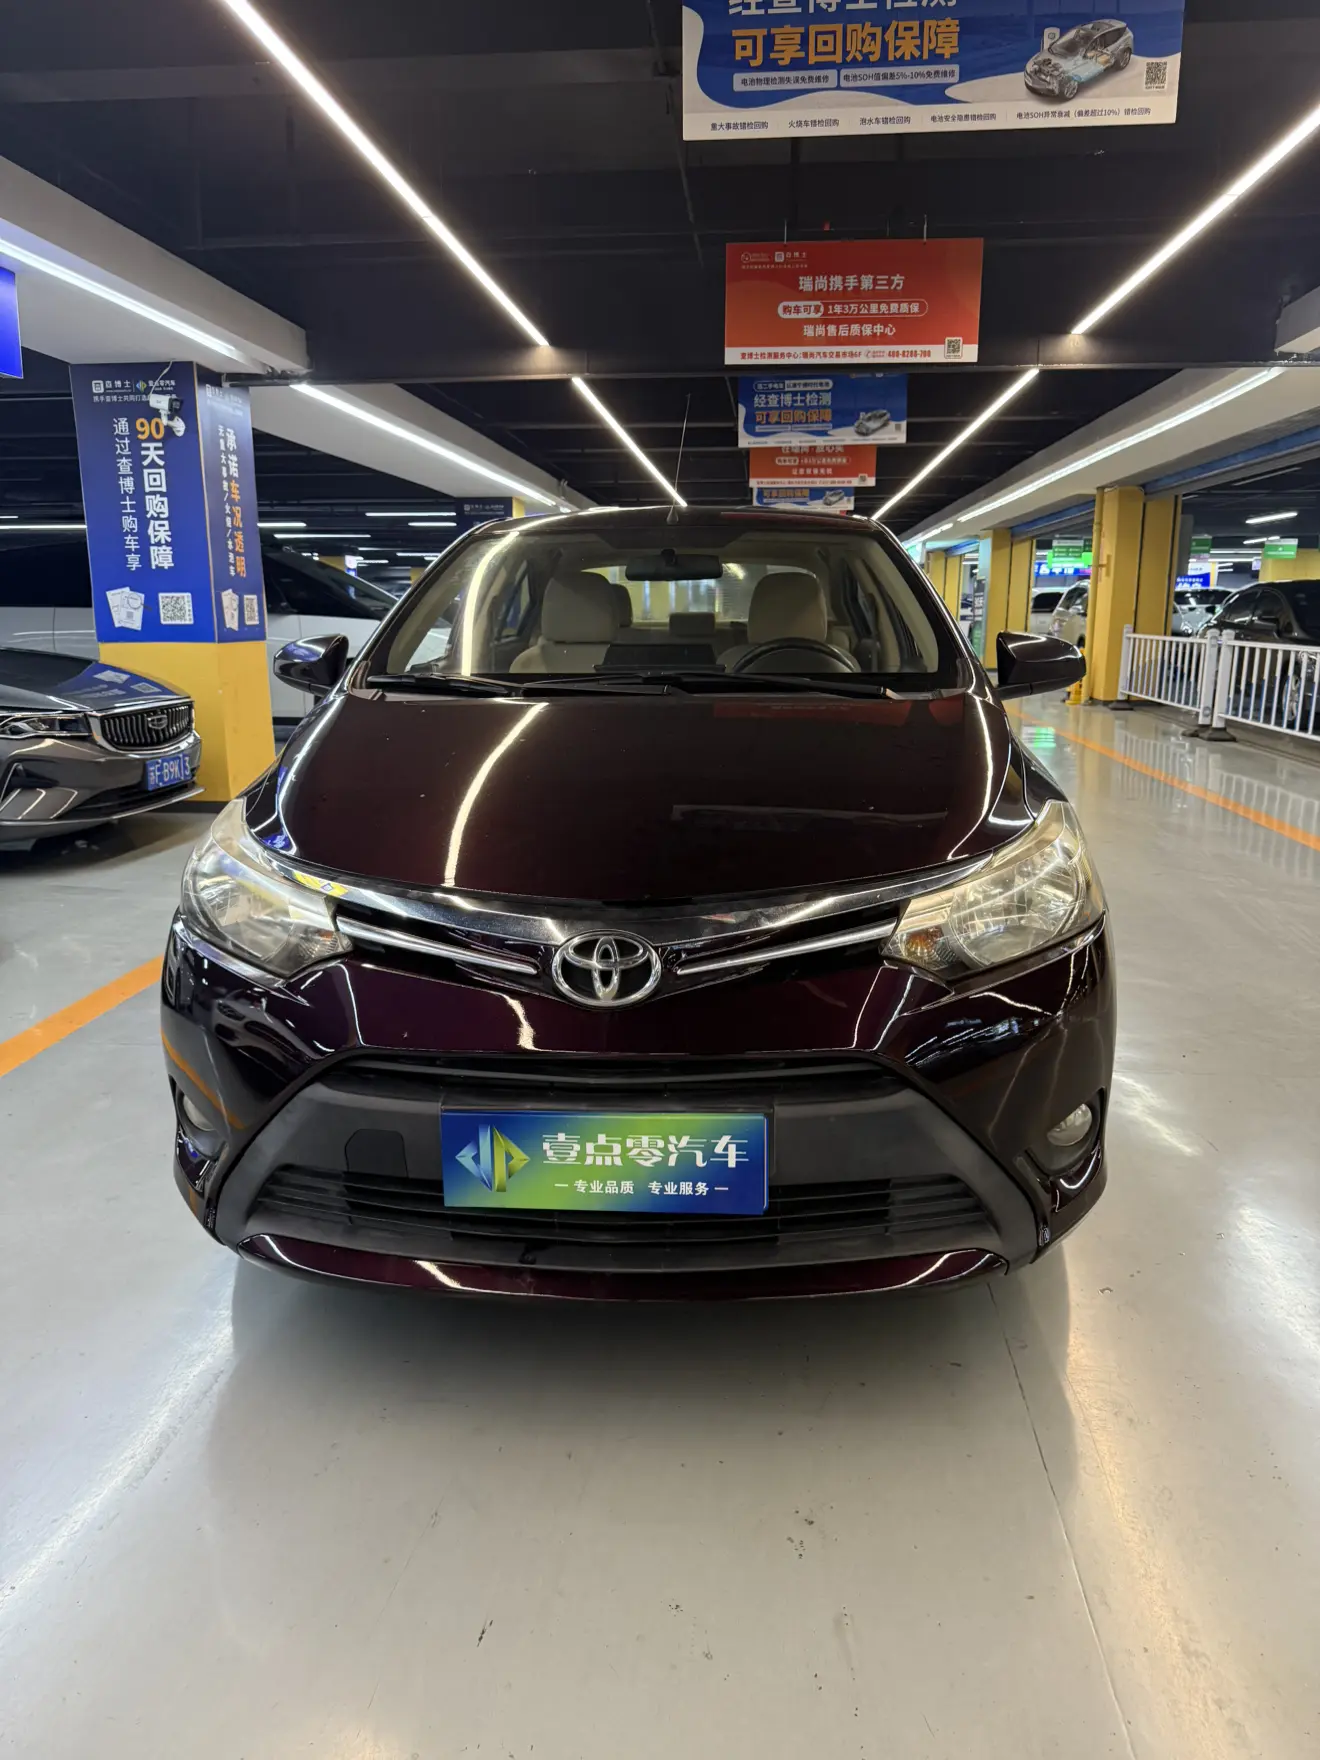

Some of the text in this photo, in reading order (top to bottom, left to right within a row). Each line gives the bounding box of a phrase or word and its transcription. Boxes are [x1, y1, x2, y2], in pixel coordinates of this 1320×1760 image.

[732, 18, 960, 67] 可享回购保障
[741, 75, 830, 87] 电池物理检测失误免费维修
[843, 69, 956, 82] 电池SOH值偏差5%-10%免费维修
[710, 121, 769, 131] 重大事故错检回购
[859, 116, 911, 126] 泡水车错检回购
[798, 274, 905, 292] 瑞尚携手第三方
[782, 302, 920, 316] 购车可享 1年3万公里免费质保
[803, 323, 896, 338] 瑞尚售后质保中心
[754, 392, 832, 408] 经查博士检测
[755, 409, 832, 424] 可享回购保障
[113, 417, 142, 571] 通过查博士购车享
[136, 417, 175, 570] 90天回购保障
[225, 428, 247, 578] 承诺车况透明
[542, 1132, 750, 1168] 壹点零汽车
[574, 1179, 709, 1196] 专业品质 专业服务
